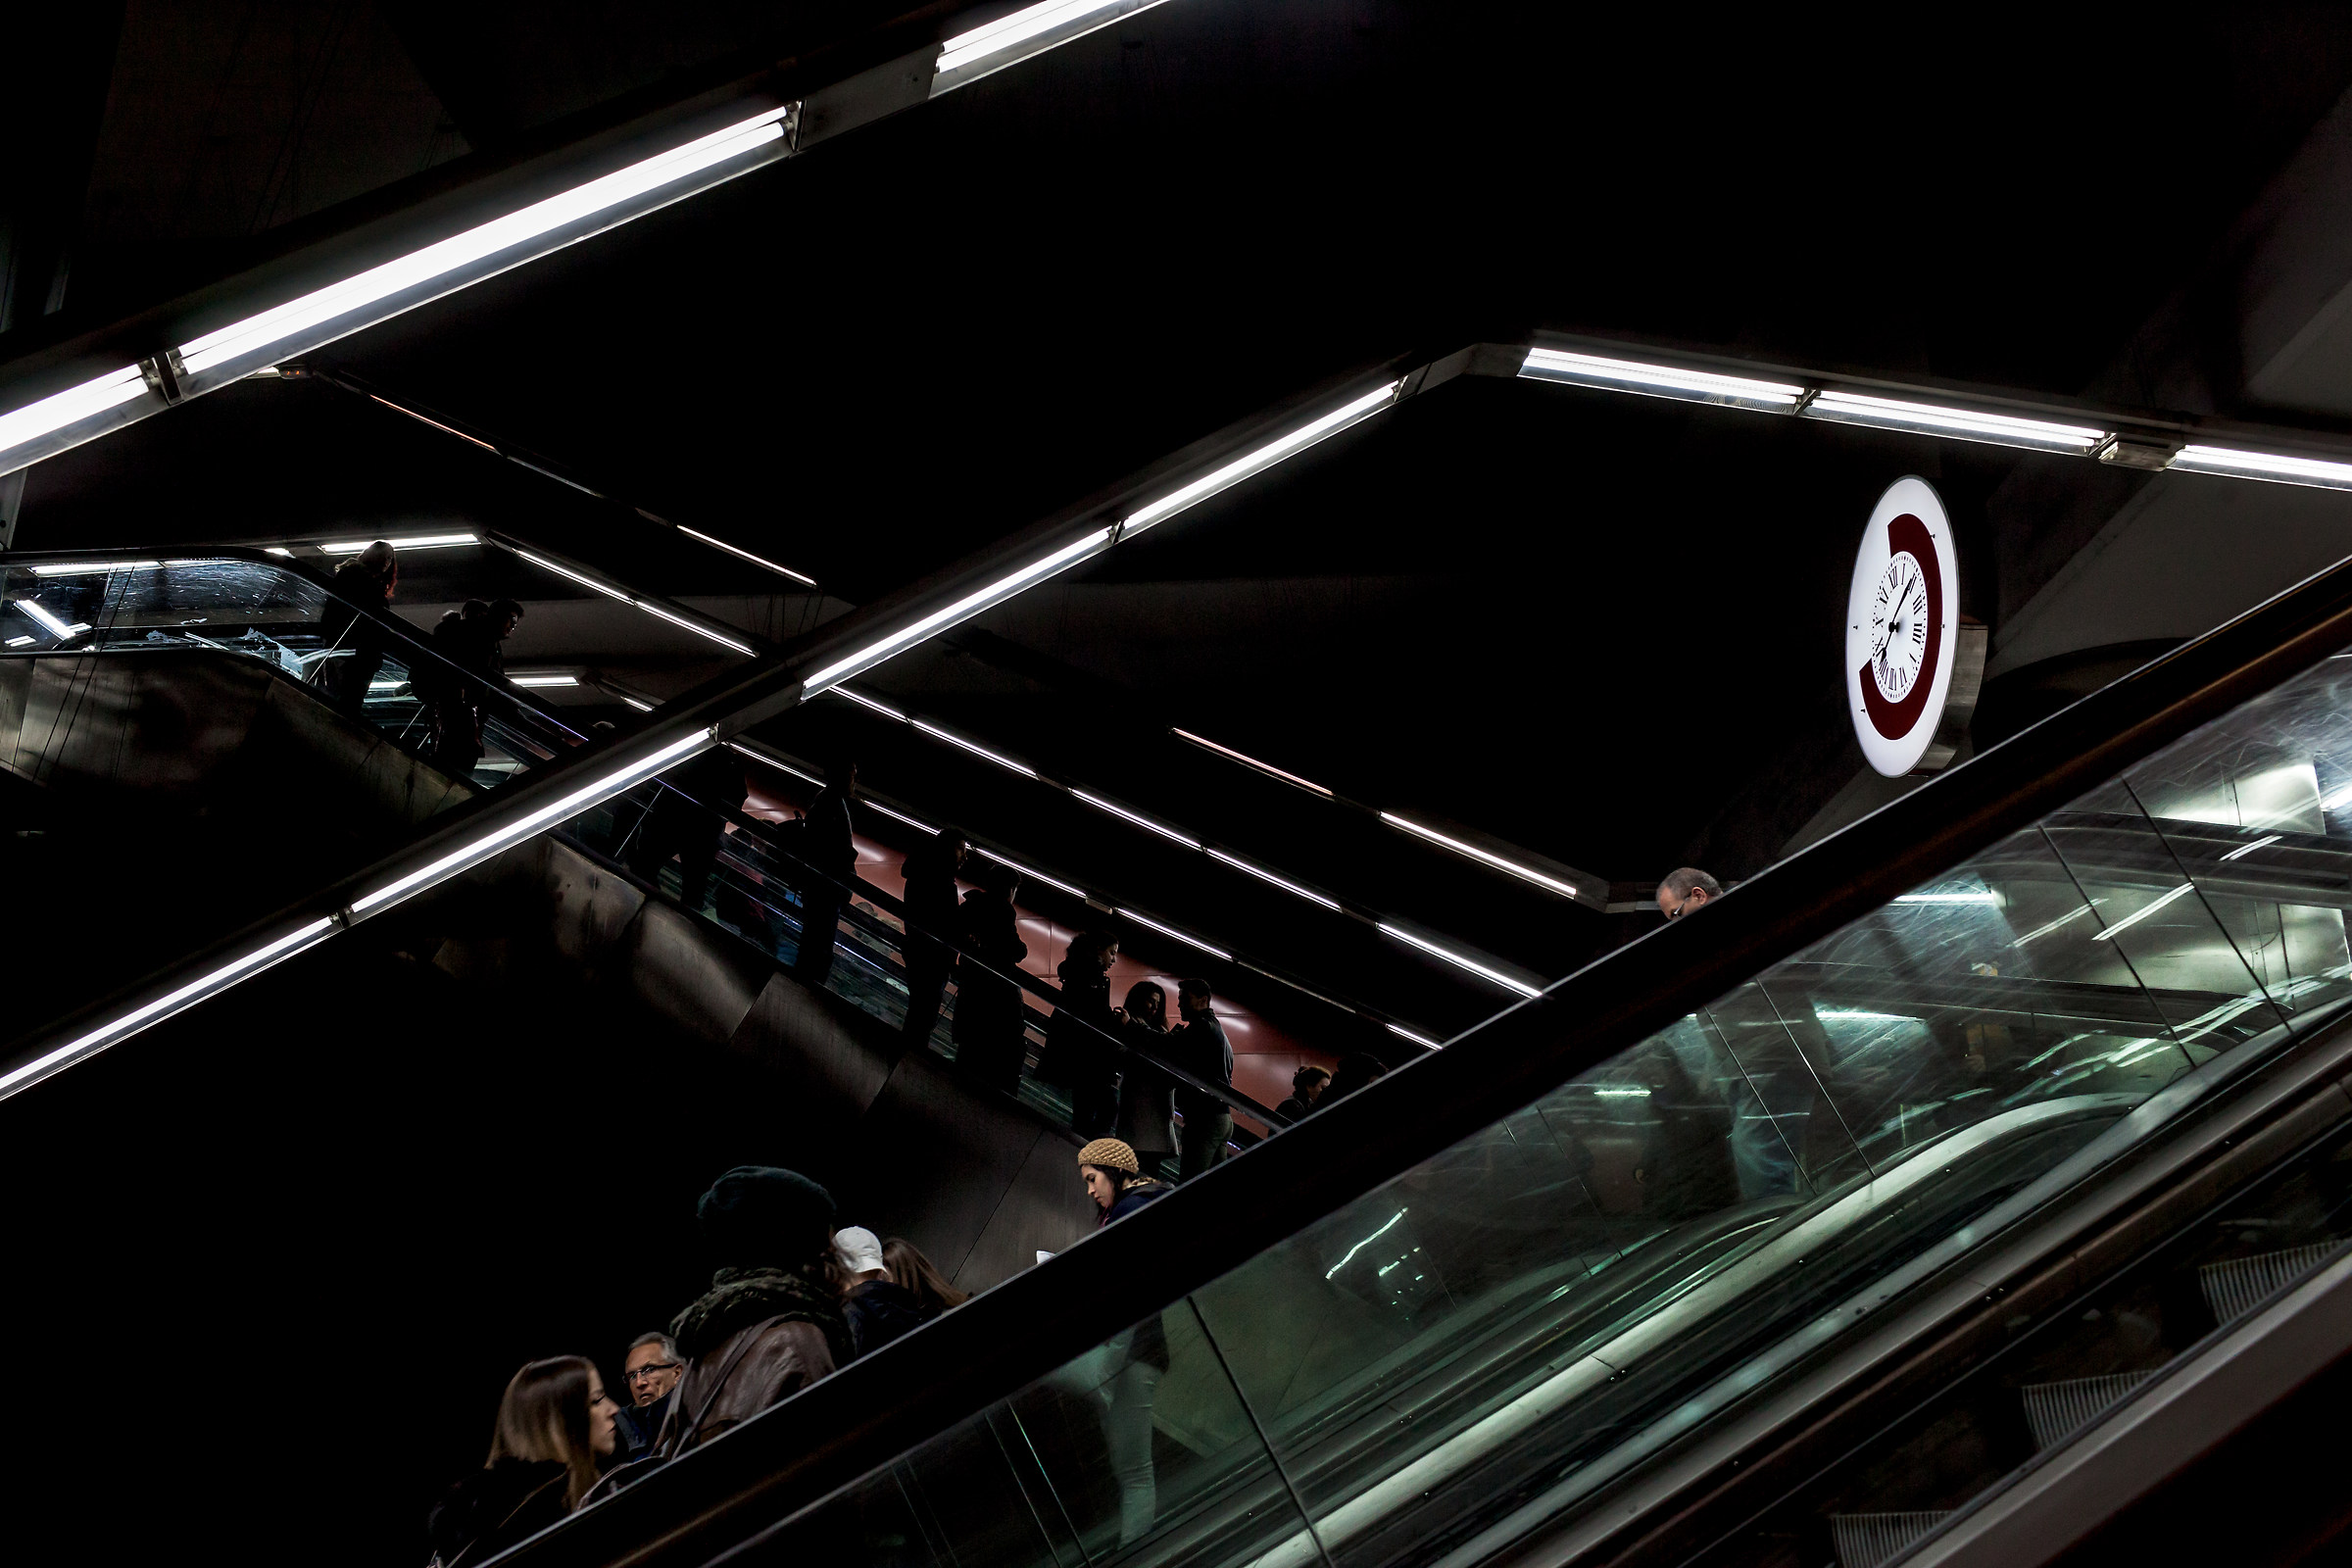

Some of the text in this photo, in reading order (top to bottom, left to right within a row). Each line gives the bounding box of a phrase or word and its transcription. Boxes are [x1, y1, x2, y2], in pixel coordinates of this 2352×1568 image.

[1888, 565, 1898, 593] XII
[1901, 563, 1905, 585] I
[1879, 587, 1888, 610] XI
[1912, 593, 1923, 615] III
[1875, 617, 1884, 628] X
[1912, 622, 1923, 645] IIII
[1875, 636, 1885, 658] IX
[1908, 653, 1917, 669] V
[1888, 667, 1897, 691] VII
[1899, 666, 1907, 688] VI
